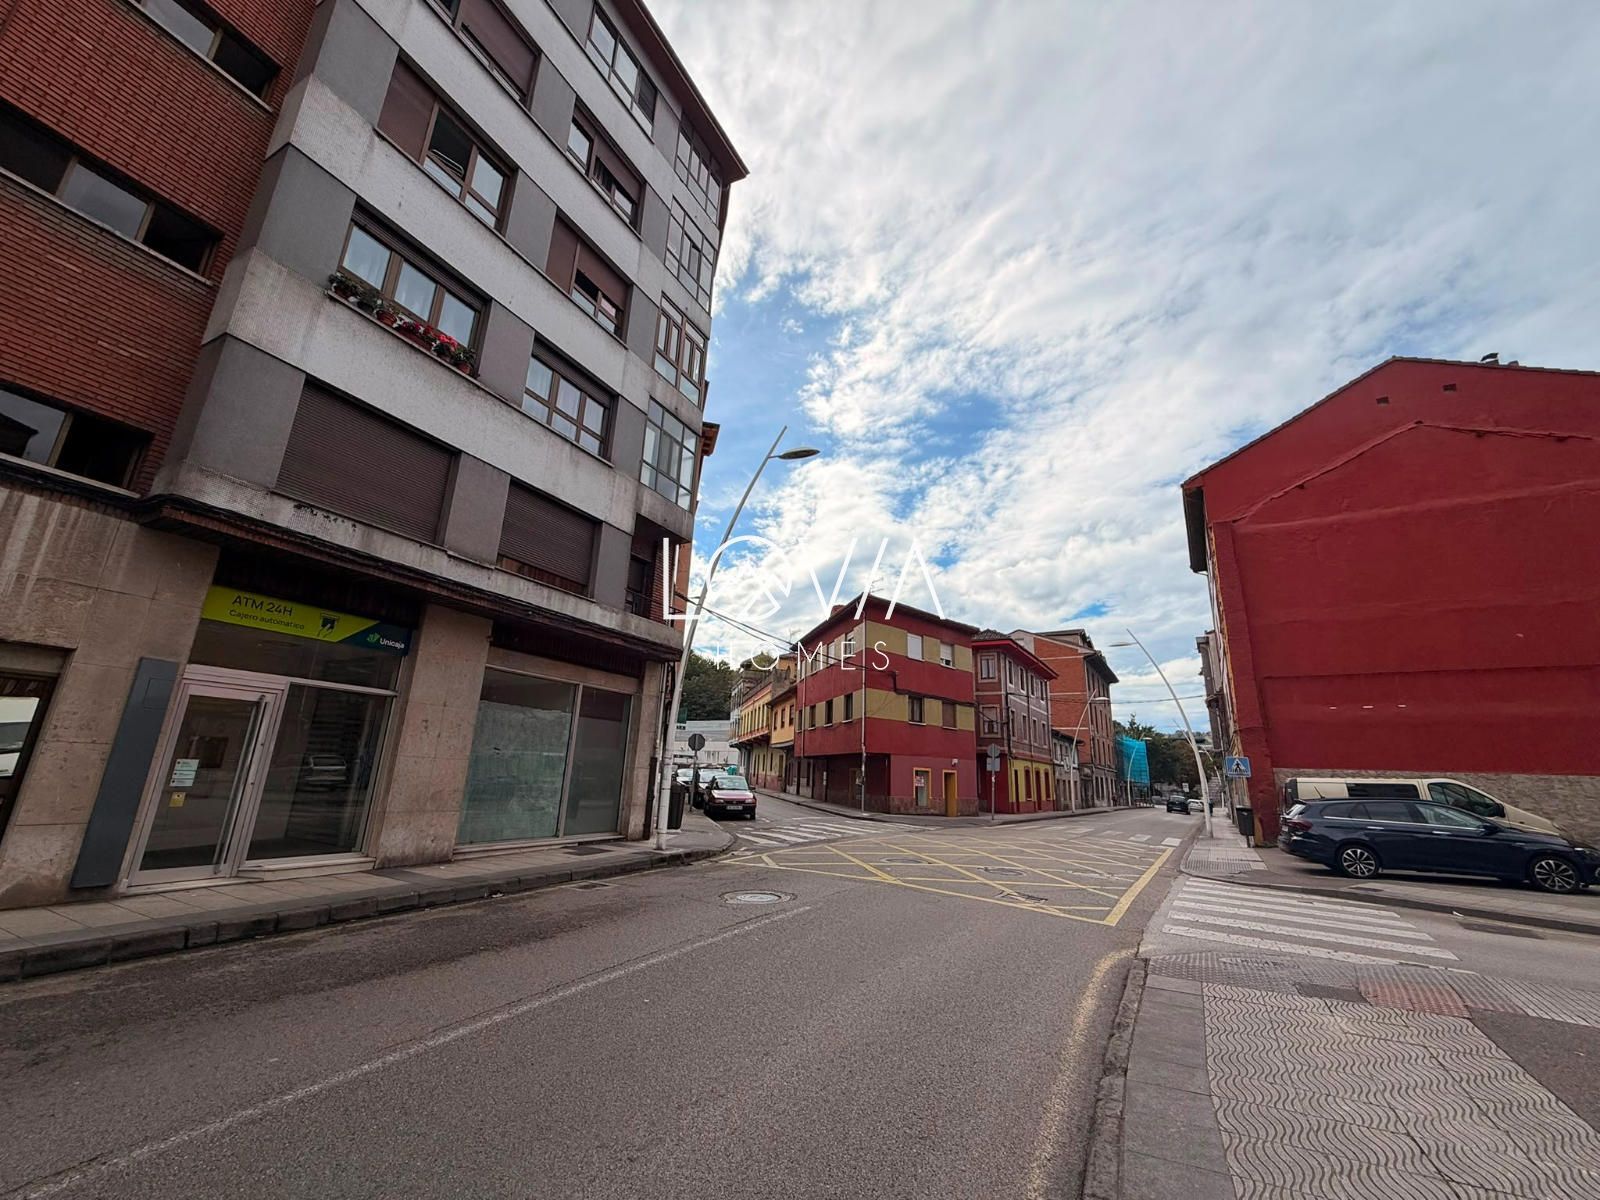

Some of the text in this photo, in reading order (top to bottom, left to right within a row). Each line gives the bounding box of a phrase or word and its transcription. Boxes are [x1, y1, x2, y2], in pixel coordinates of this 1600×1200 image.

[232, 594, 293, 617] ATM 24H
[228, 609, 258, 621] Cajero
[379, 637, 405, 649] Unicaja
